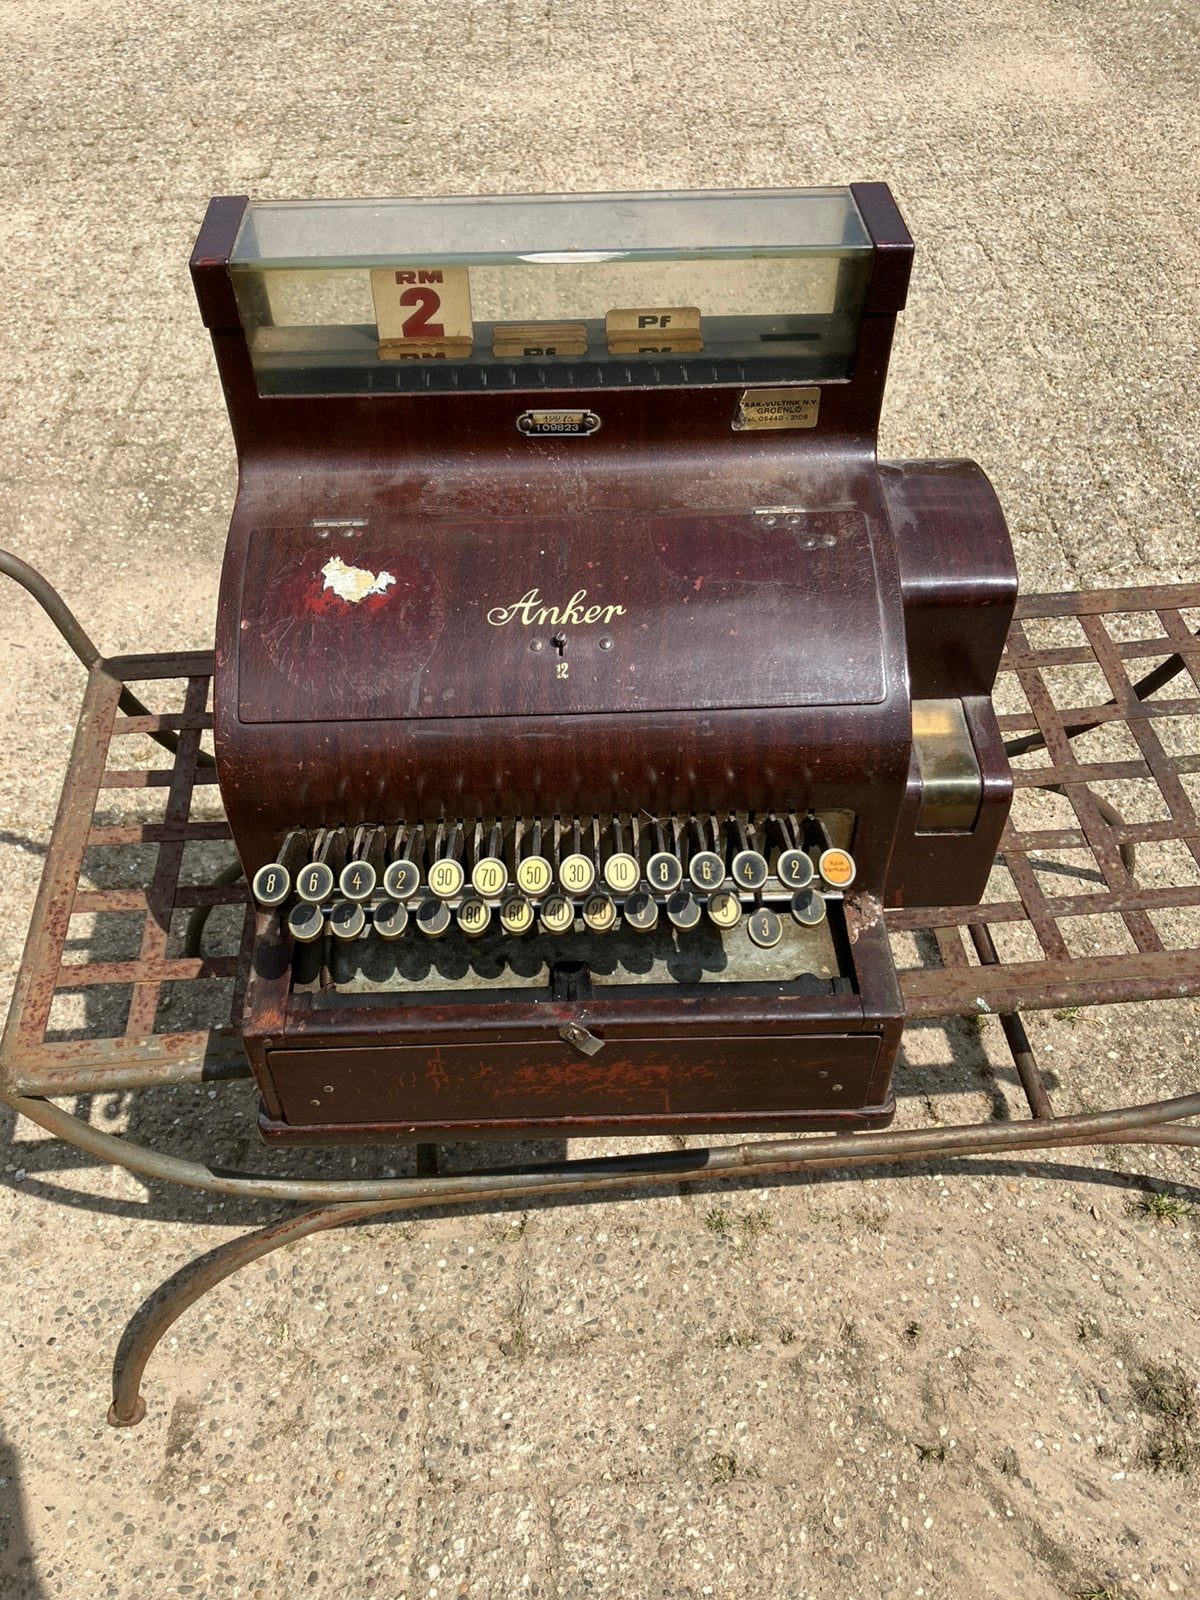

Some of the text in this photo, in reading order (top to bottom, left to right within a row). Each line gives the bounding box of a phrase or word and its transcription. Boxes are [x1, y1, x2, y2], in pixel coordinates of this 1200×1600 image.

[395, 270, 444, 285] RM
[400, 287, 445, 337] 2
[757, 406, 802, 415] GROENLO
[535, 424, 579, 432] 109823
[487, 588, 627, 626] Anker
[556, 662, 569, 679] 12
[437, 868, 453, 886] 90
[481, 868, 497, 887] 70
[526, 866, 541, 884] 50
[569, 864, 584, 882] 30
[613, 862, 628, 881] 10
[660, 862, 669, 882] 8
[702, 861, 711, 880] 6
[744, 862, 754, 880] 4
[791, 860, 800, 879] 2
[266, 873, 276, 893] 8
[309, 872, 319, 892] 6
[352, 872, 362, 891] 4
[396, 870, 407, 889] 2
[465, 906, 481, 924] 80
[508, 904, 524, 922] 60
[550, 902, 565, 921] 40
[592, 902, 607, 920] 20
[721, 901, 730, 918] 5
[761, 917, 770, 937] 3
